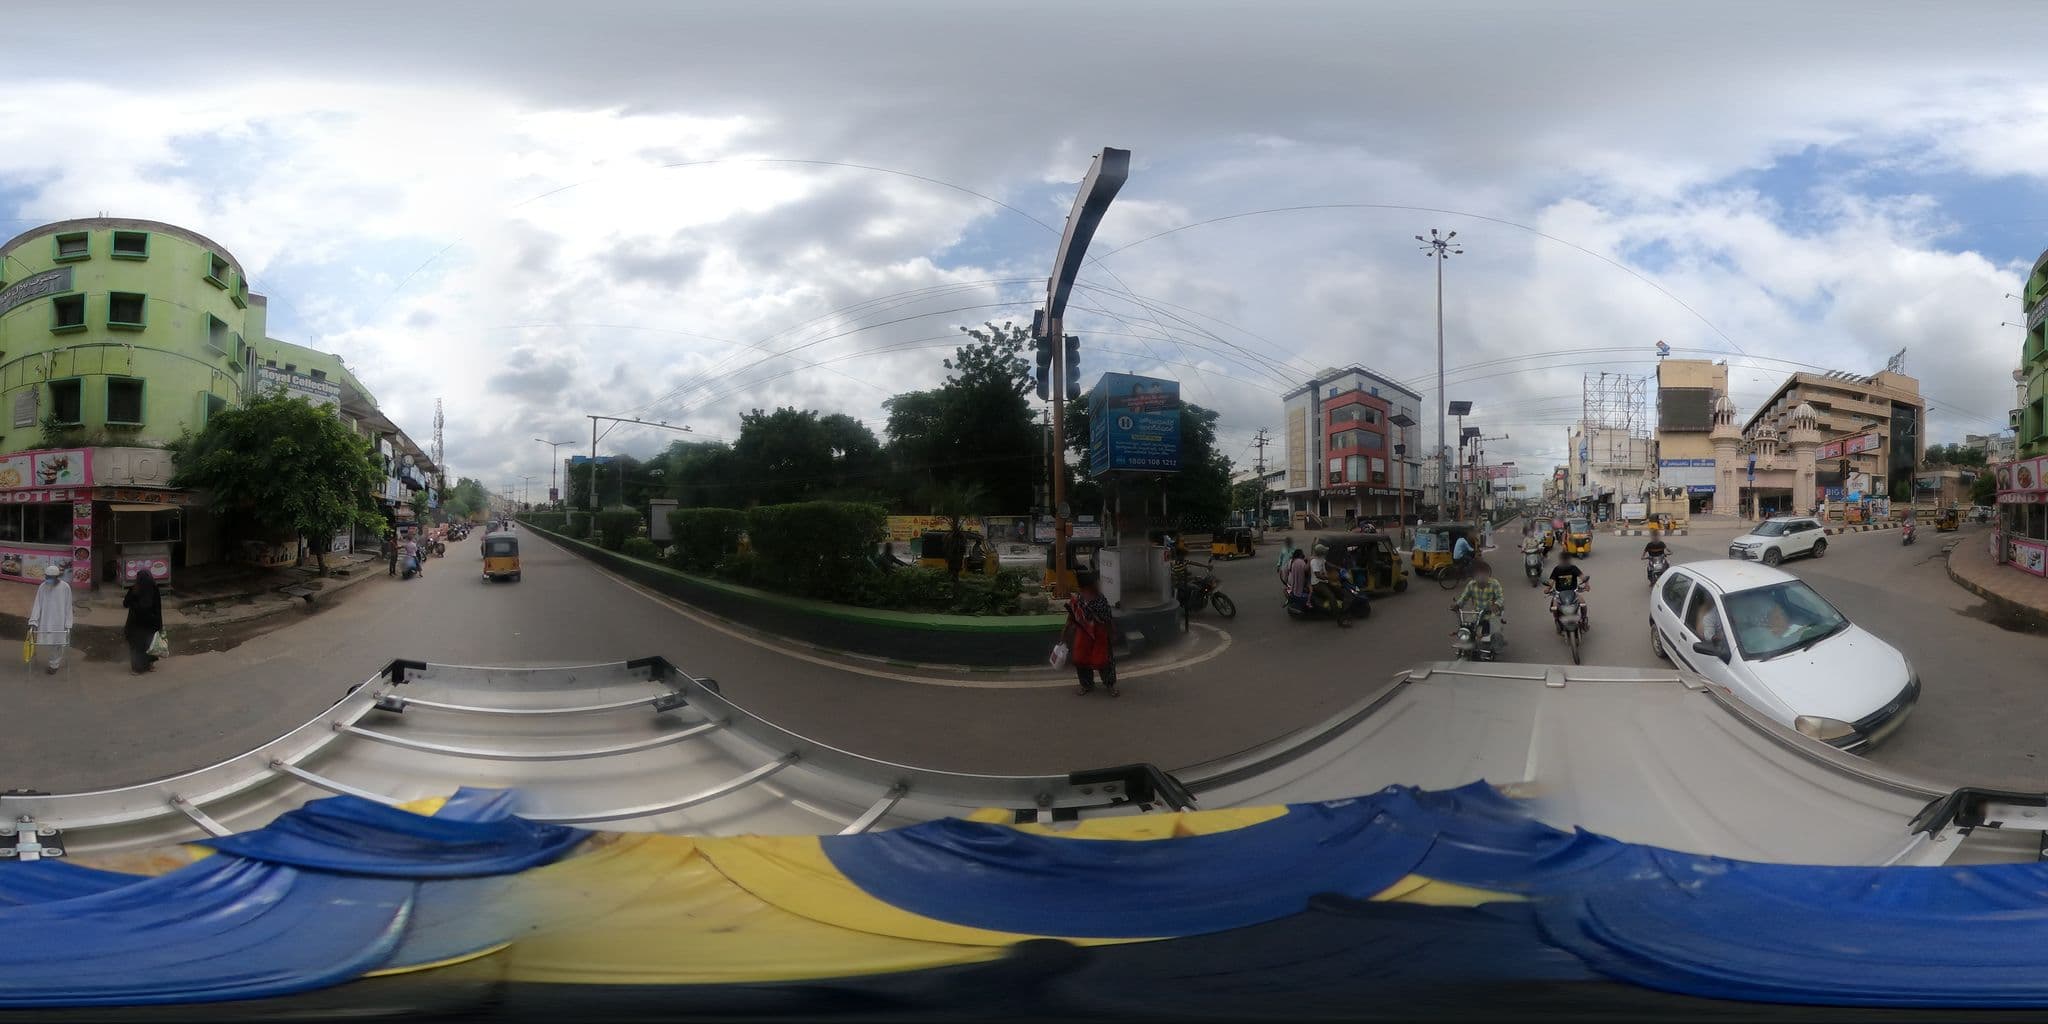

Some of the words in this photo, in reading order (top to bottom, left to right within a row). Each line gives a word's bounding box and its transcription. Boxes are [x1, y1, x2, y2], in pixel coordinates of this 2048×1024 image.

[261, 369, 291, 384] Royal
[292, 376, 340, 395] Collection
[0, 489, 84, 503] HOTEL
[1826, 488, 1840, 496] BIG
[1999, 492, 2040, 503] OUND
